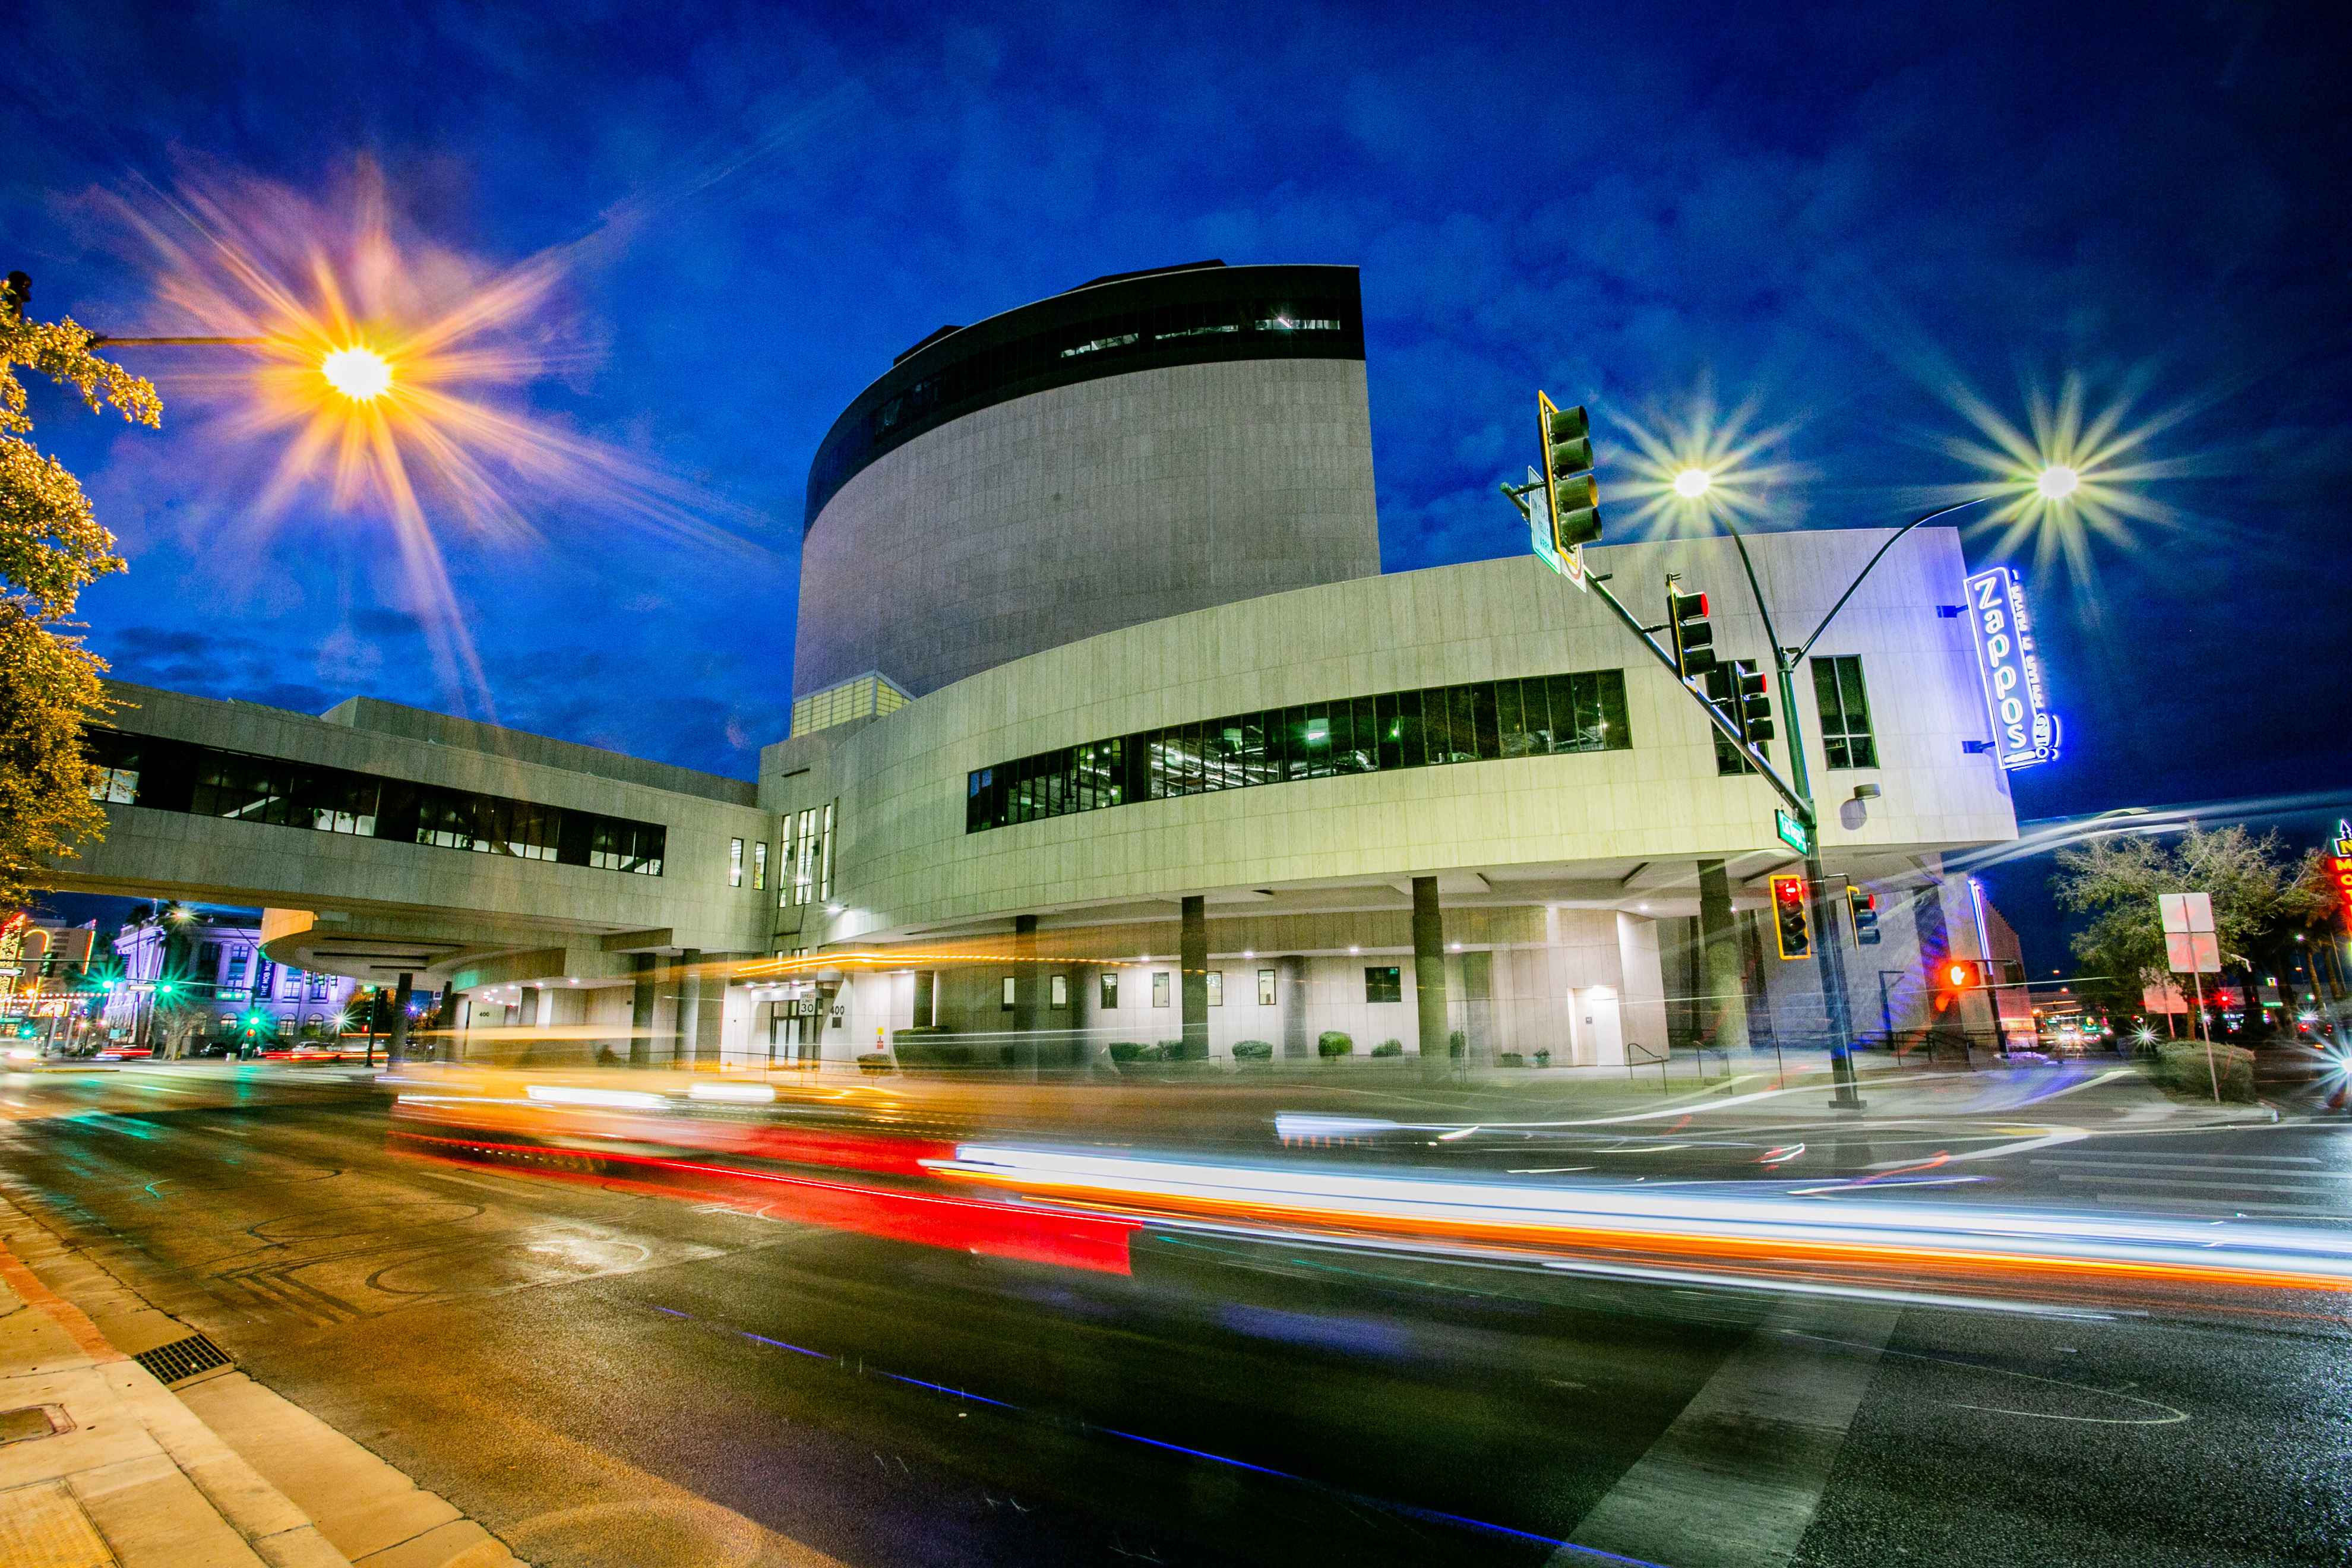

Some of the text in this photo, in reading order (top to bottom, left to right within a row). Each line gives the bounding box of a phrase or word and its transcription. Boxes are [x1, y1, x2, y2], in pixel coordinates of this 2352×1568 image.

[1974, 576, 2026, 748] Zappos
[262, 972, 271, 984] MOB
[260, 985, 268, 996] THE
[801, 1003, 814, 1012] 30
[830, 1005, 845, 1016] 400
